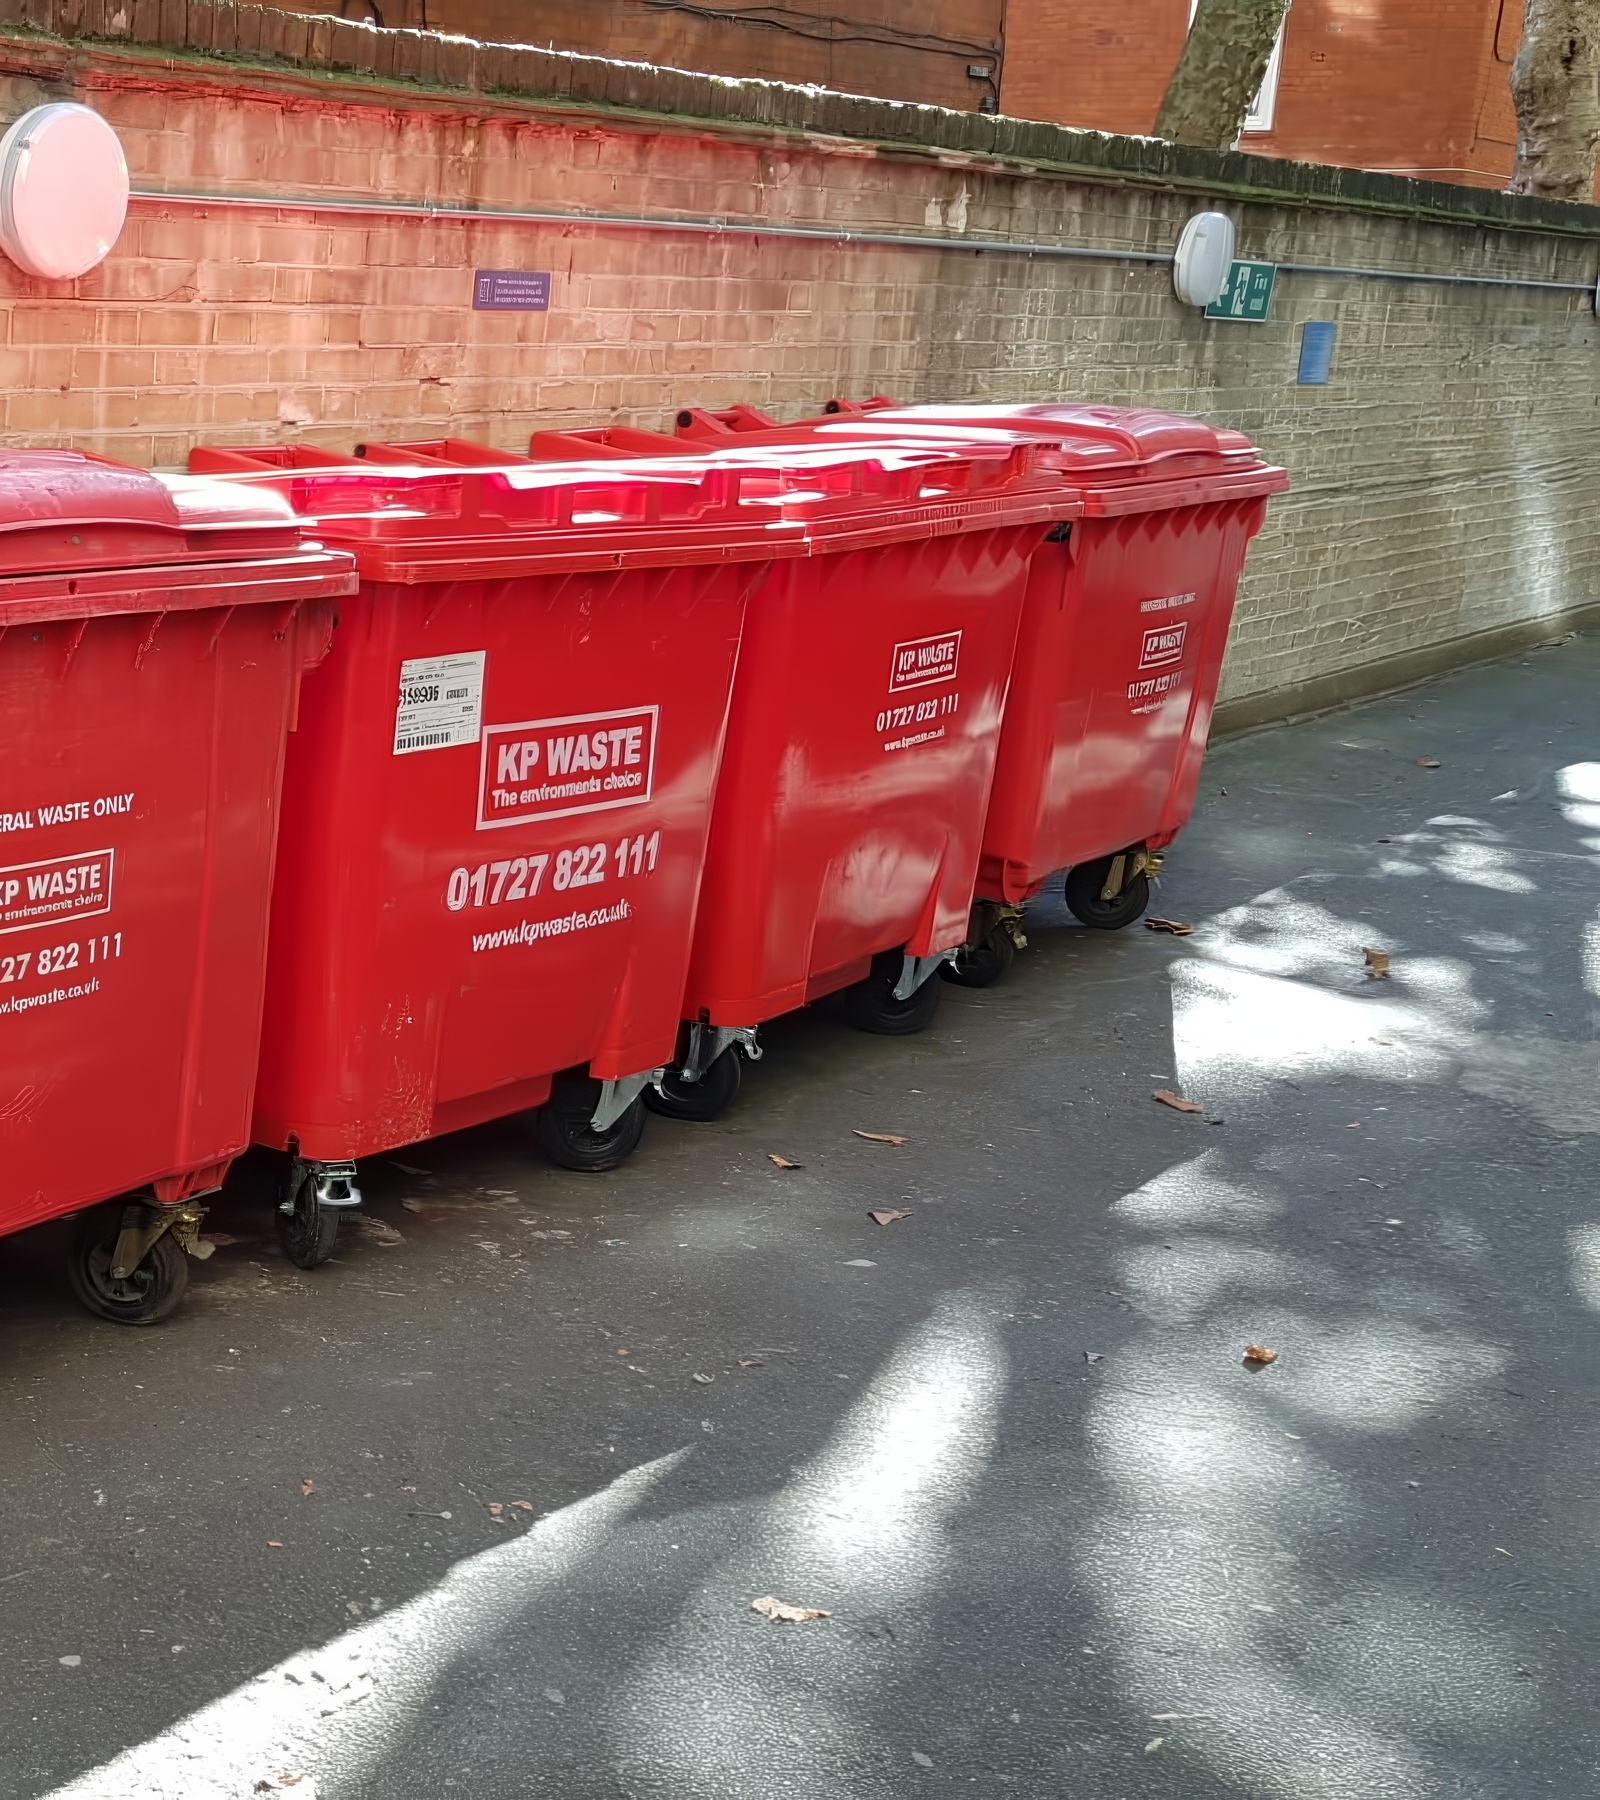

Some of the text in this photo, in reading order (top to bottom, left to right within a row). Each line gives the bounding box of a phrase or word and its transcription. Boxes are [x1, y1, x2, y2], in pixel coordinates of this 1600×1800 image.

[876, 705, 915, 732] 01727
[941, 693, 959, 715] 111
[497, 726, 643, 784] KP WASTE
[37, 801, 89, 827] WASTE
[94, 793, 135, 816] ONLY
[492, 789, 517, 808] The
[27, 864, 101, 900] WASTE
[447, 831, 660, 911] 01727 822 111
[37, 942, 79, 975] 822
[88, 932, 122, 964] 111
